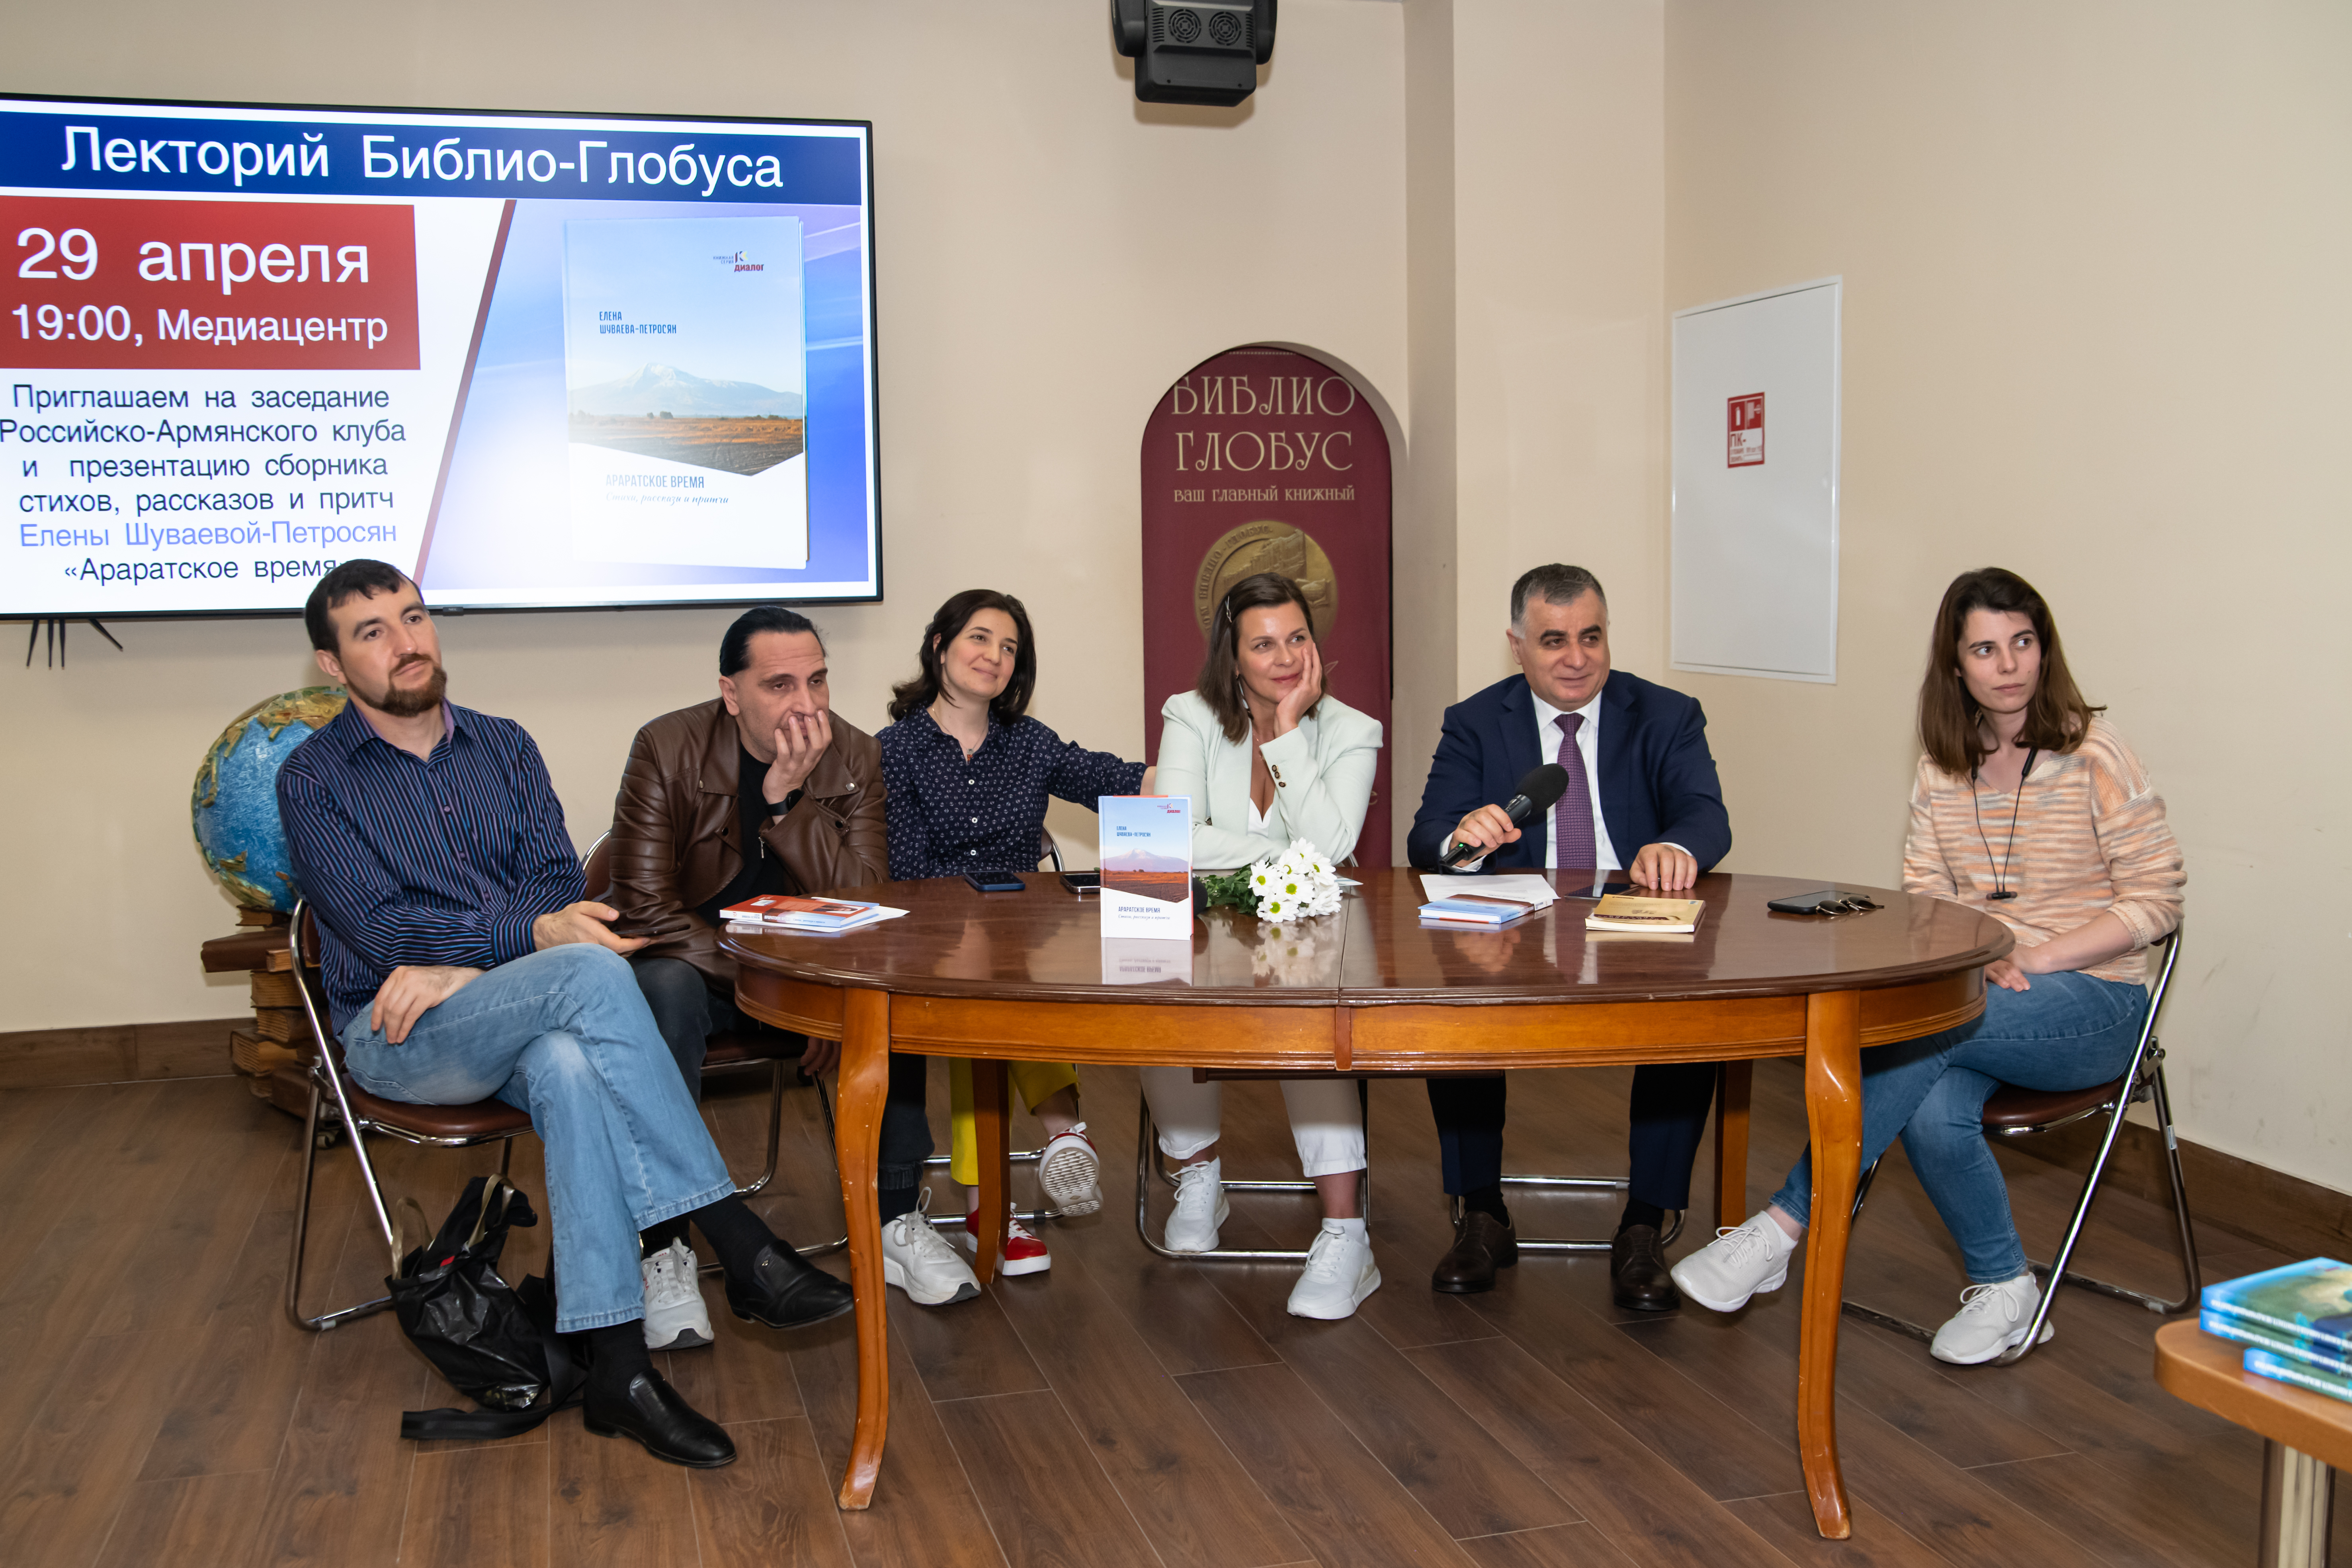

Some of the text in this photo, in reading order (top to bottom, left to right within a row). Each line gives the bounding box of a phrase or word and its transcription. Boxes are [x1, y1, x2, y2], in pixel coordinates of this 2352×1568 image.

[62, 125, 783, 197] Лекторий Библио-Глобуса
[18, 227, 369, 295] 29 апреля
[12, 304, 388, 350] 19:00, Медиацентр
[599, 311, 622, 321] ЕЛЕНА
[600, 324, 677, 334] ШУВАЕВА-ПЕТРОСЯН
[13, 384, 389, 414] Приглашаем на заседание
[1171, 375, 1354, 416] БИБЛИО
[0, 419, 406, 448] Российско-Армянского клуба
[1175, 430, 1353, 471] ГЛОБУС
[23, 453, 388, 483] и презентацию сборника
[606, 474, 704, 488] АРАРАТСКОЕ ВРЕМЯ
[19, 491, 393, 517] стихов, рассказов и притч
[1174, 485, 1355, 502] ваш главный книжный
[20, 520, 397, 551] Елены Шуваевой-Петросян
[65, 558, 239, 586] «Араратское
